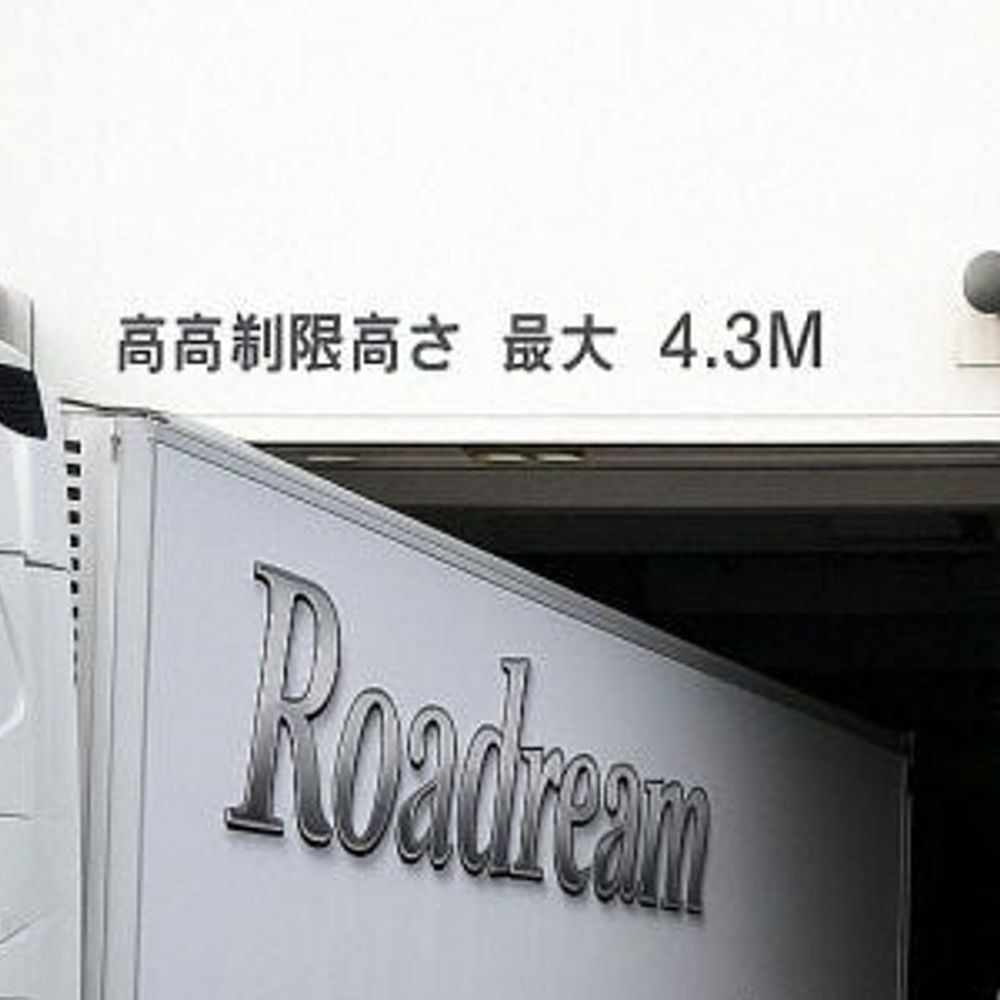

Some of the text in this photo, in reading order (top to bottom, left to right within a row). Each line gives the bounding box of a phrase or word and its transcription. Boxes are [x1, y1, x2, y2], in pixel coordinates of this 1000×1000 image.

[503, 313, 616, 372] 最大
[659, 310, 822, 370] 4.3M
[225, 561, 712, 915] Roadream
